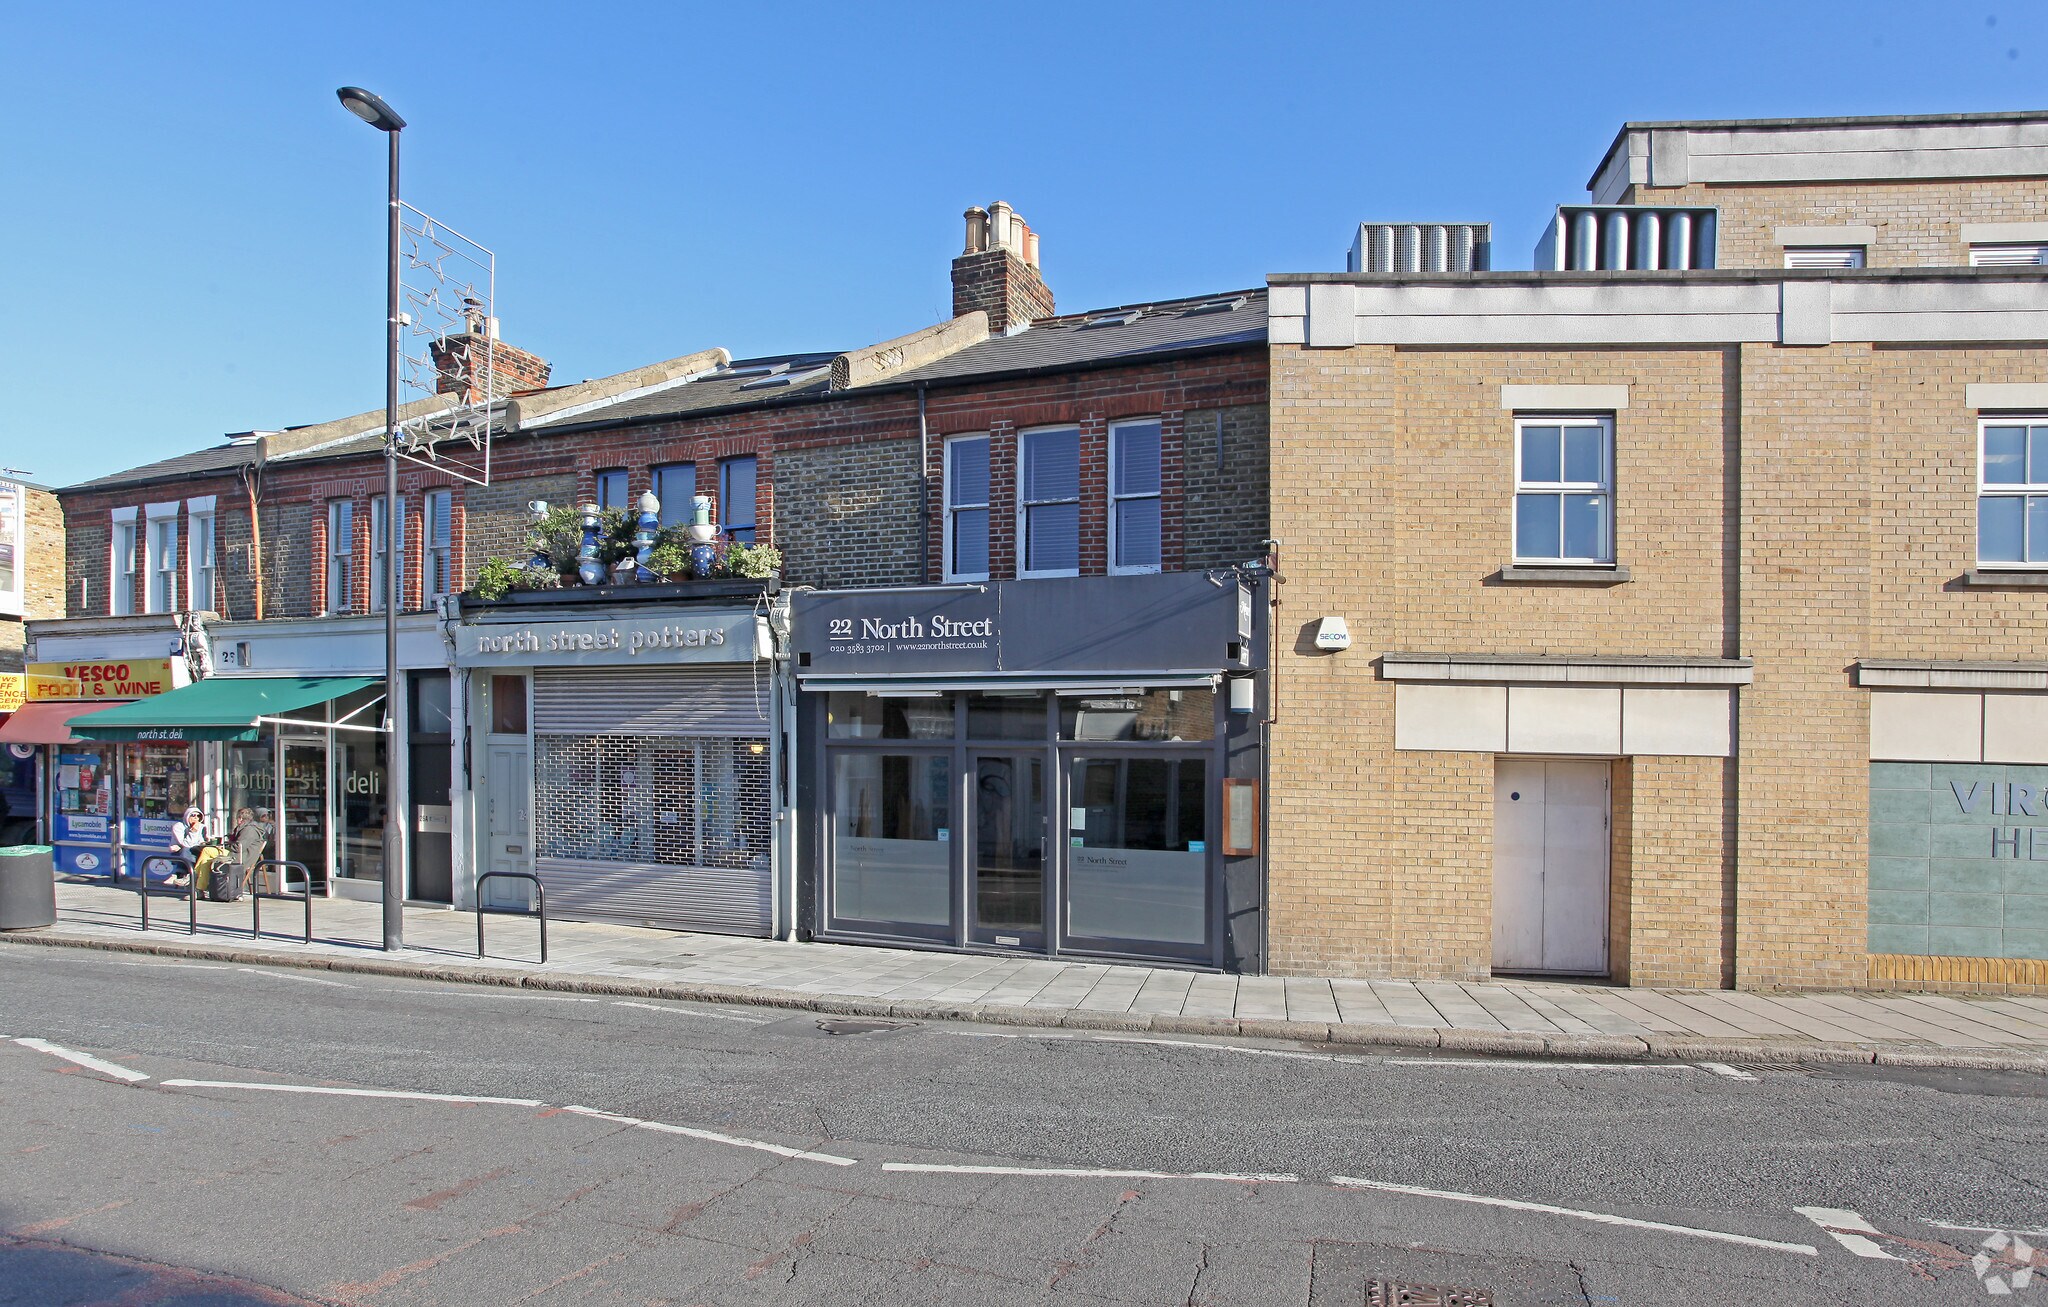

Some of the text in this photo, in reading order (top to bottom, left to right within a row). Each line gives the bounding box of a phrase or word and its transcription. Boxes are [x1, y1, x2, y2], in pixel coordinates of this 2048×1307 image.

[829, 615, 992, 640] 22 North Street
[479, 626, 724, 655] north street potters
[847, 643, 864, 654] 3583
[866, 644, 885, 654] 3702
[896, 640, 988, 651] www.22northstreet.co.uk
[64, 664, 130, 682] VESCO
[37, 681, 161, 697] FOOD & WINE
[137, 728, 158, 739] north
[169, 728, 184, 739] deli
[229, 767, 272, 790] north
[346, 770, 379, 795] deli
[1949, 780, 2048, 817] VIR
[71, 819, 102, 829] Lycamobile
[1087, 856, 1107, 864] North
[1108, 857, 1128, 866] Street
